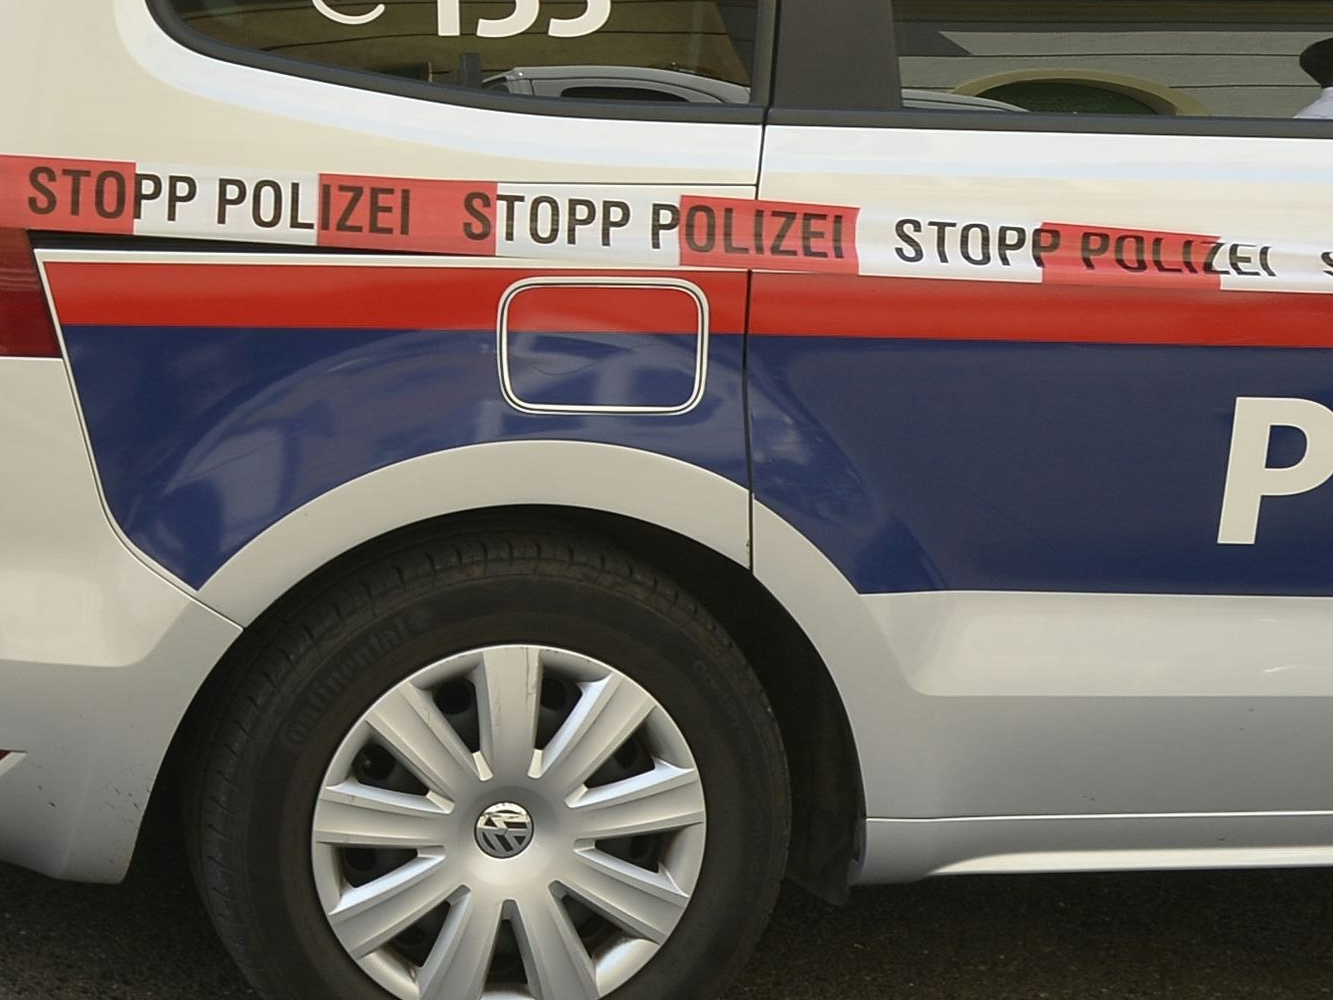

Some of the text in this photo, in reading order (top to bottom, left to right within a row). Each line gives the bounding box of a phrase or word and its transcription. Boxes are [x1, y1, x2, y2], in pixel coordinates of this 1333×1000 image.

[27, 165, 197, 222] STOPP
[217, 177, 411, 236] POLIZEI
[462, 191, 631, 247] STOPP
[651, 203, 845, 260] POLIZEI
[894, 217, 1061, 268] STOPP
[1080, 231, 1277, 278] POLIZEI
